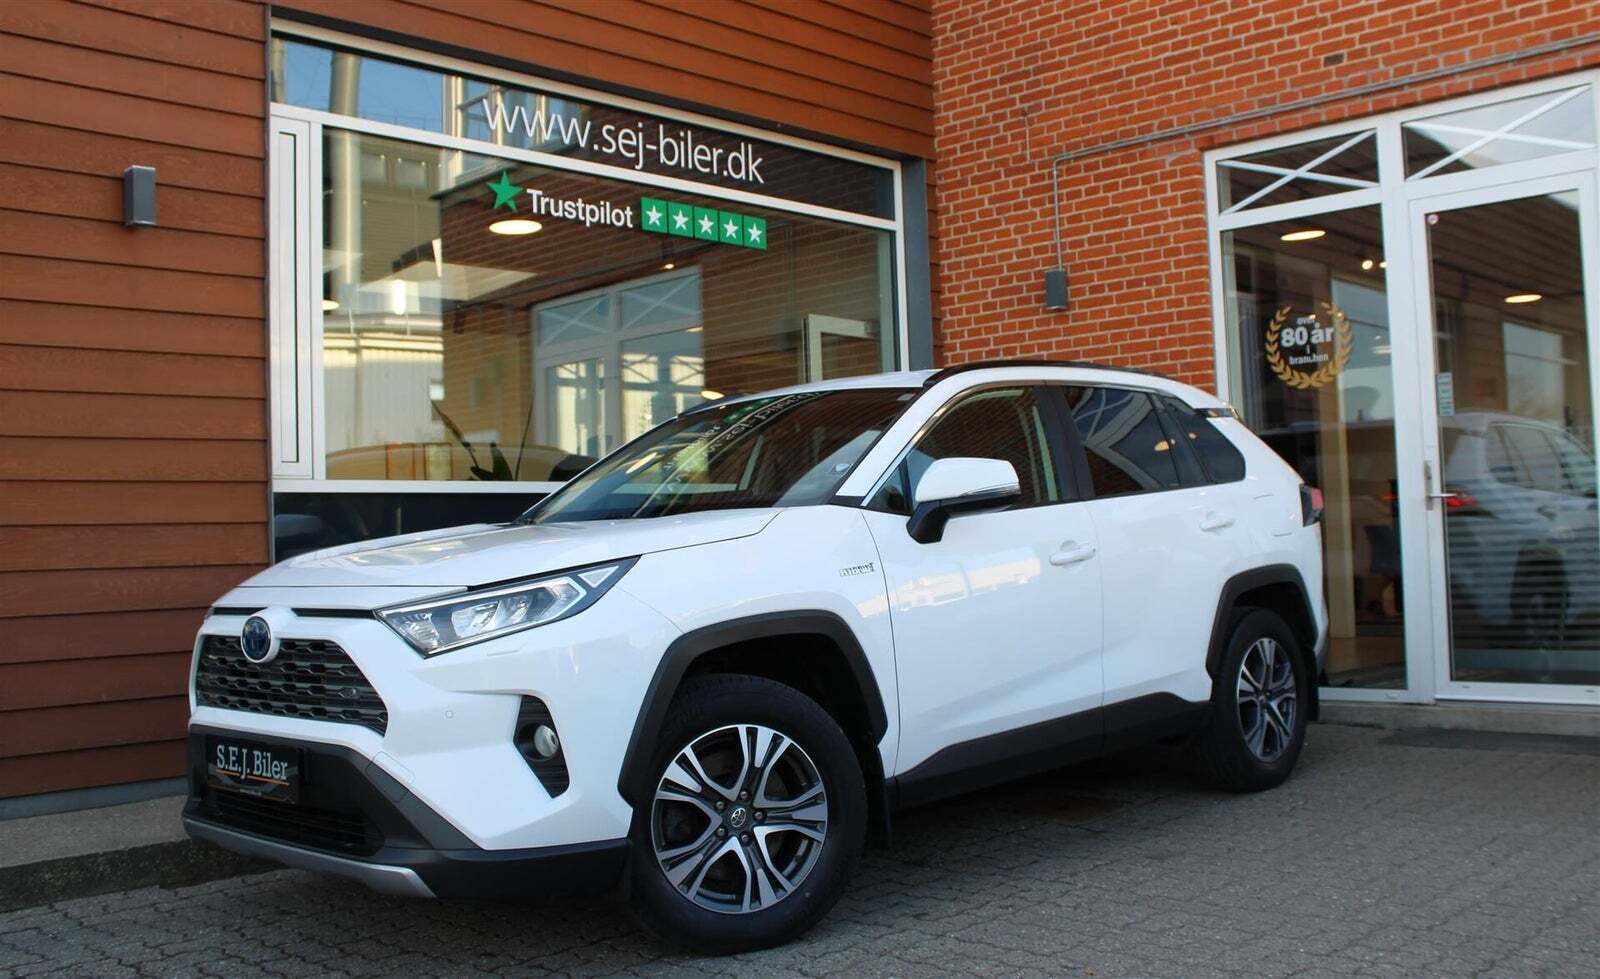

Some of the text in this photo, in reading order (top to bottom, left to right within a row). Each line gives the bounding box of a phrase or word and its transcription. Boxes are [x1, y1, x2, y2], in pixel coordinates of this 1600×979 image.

[482, 98, 765, 184] www.sej-biler.dk
[526, 188, 633, 228] Trustpilot
[1280, 322, 1334, 347] 80 år
[216, 744, 288, 780] S.E.J. Biler
